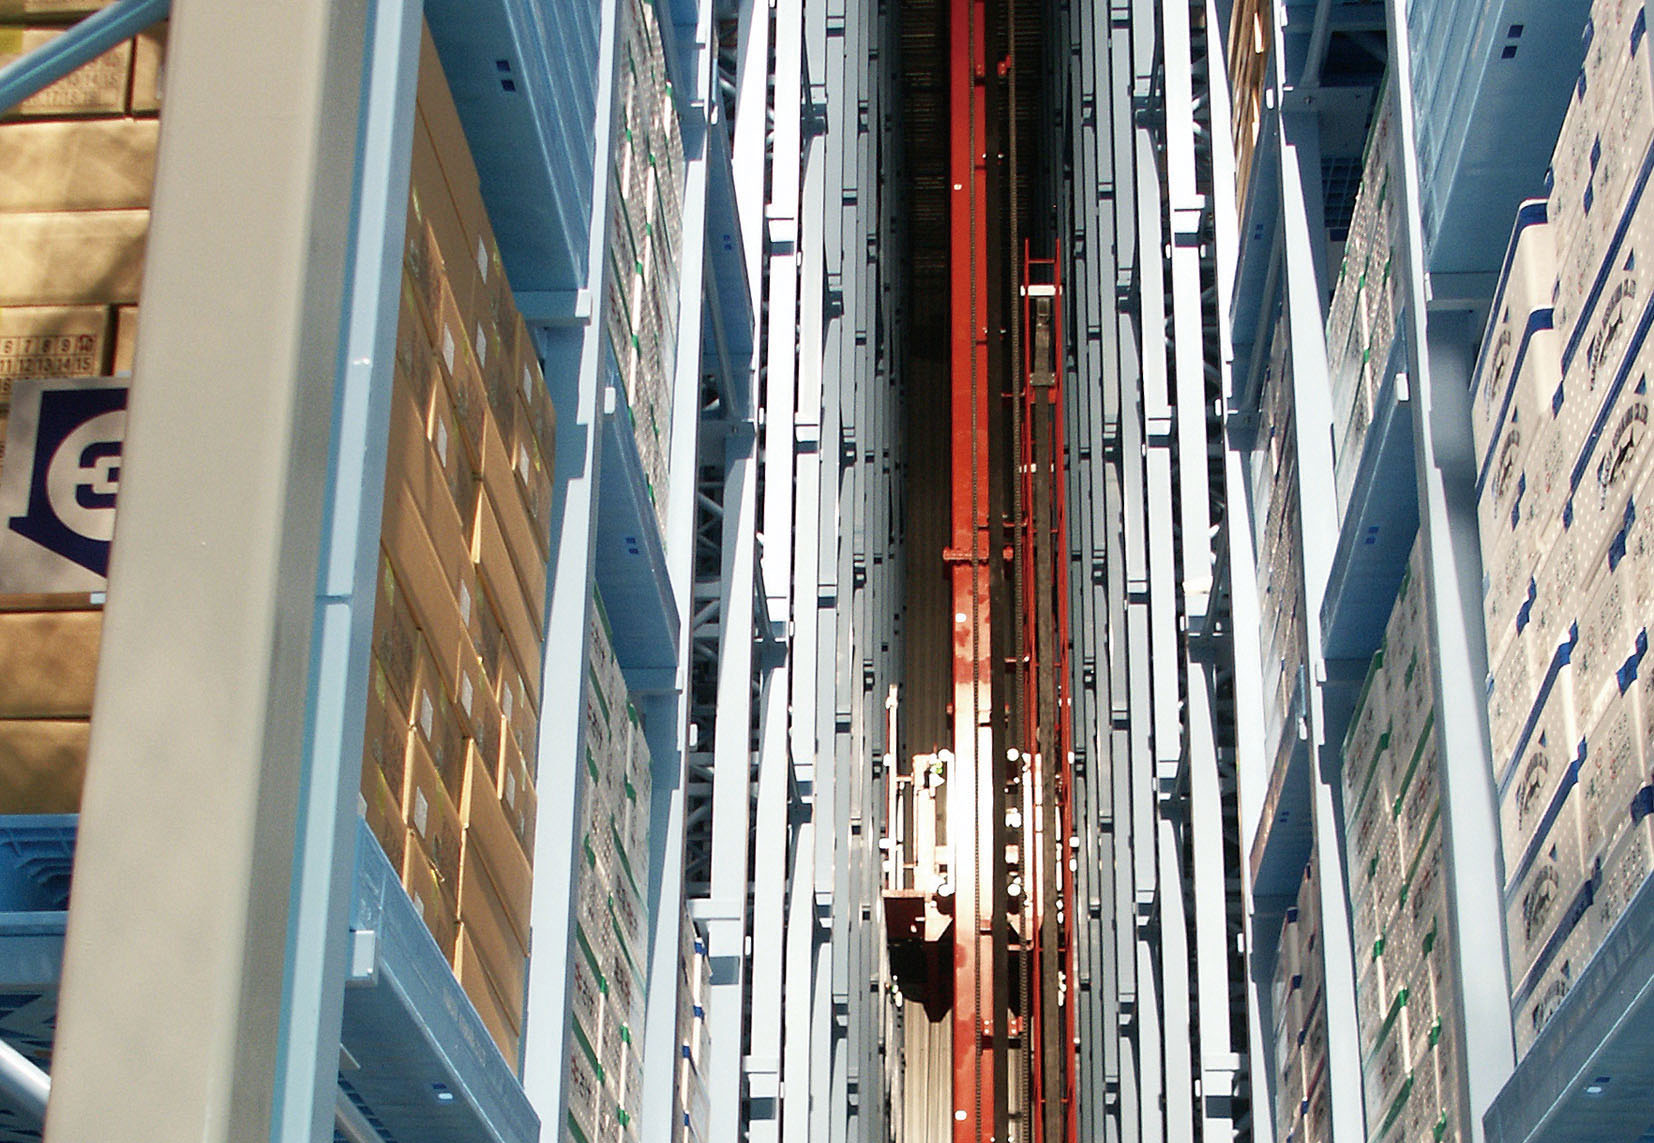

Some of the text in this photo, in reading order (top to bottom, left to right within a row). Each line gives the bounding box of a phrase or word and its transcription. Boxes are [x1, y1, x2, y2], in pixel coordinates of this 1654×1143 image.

[61, 339, 71, 352] 9
[20, 358, 33, 372] 12
[39, 358, 52, 372] 13
[57, 358, 71, 371] 14
[77, 357, 92, 371] 15
